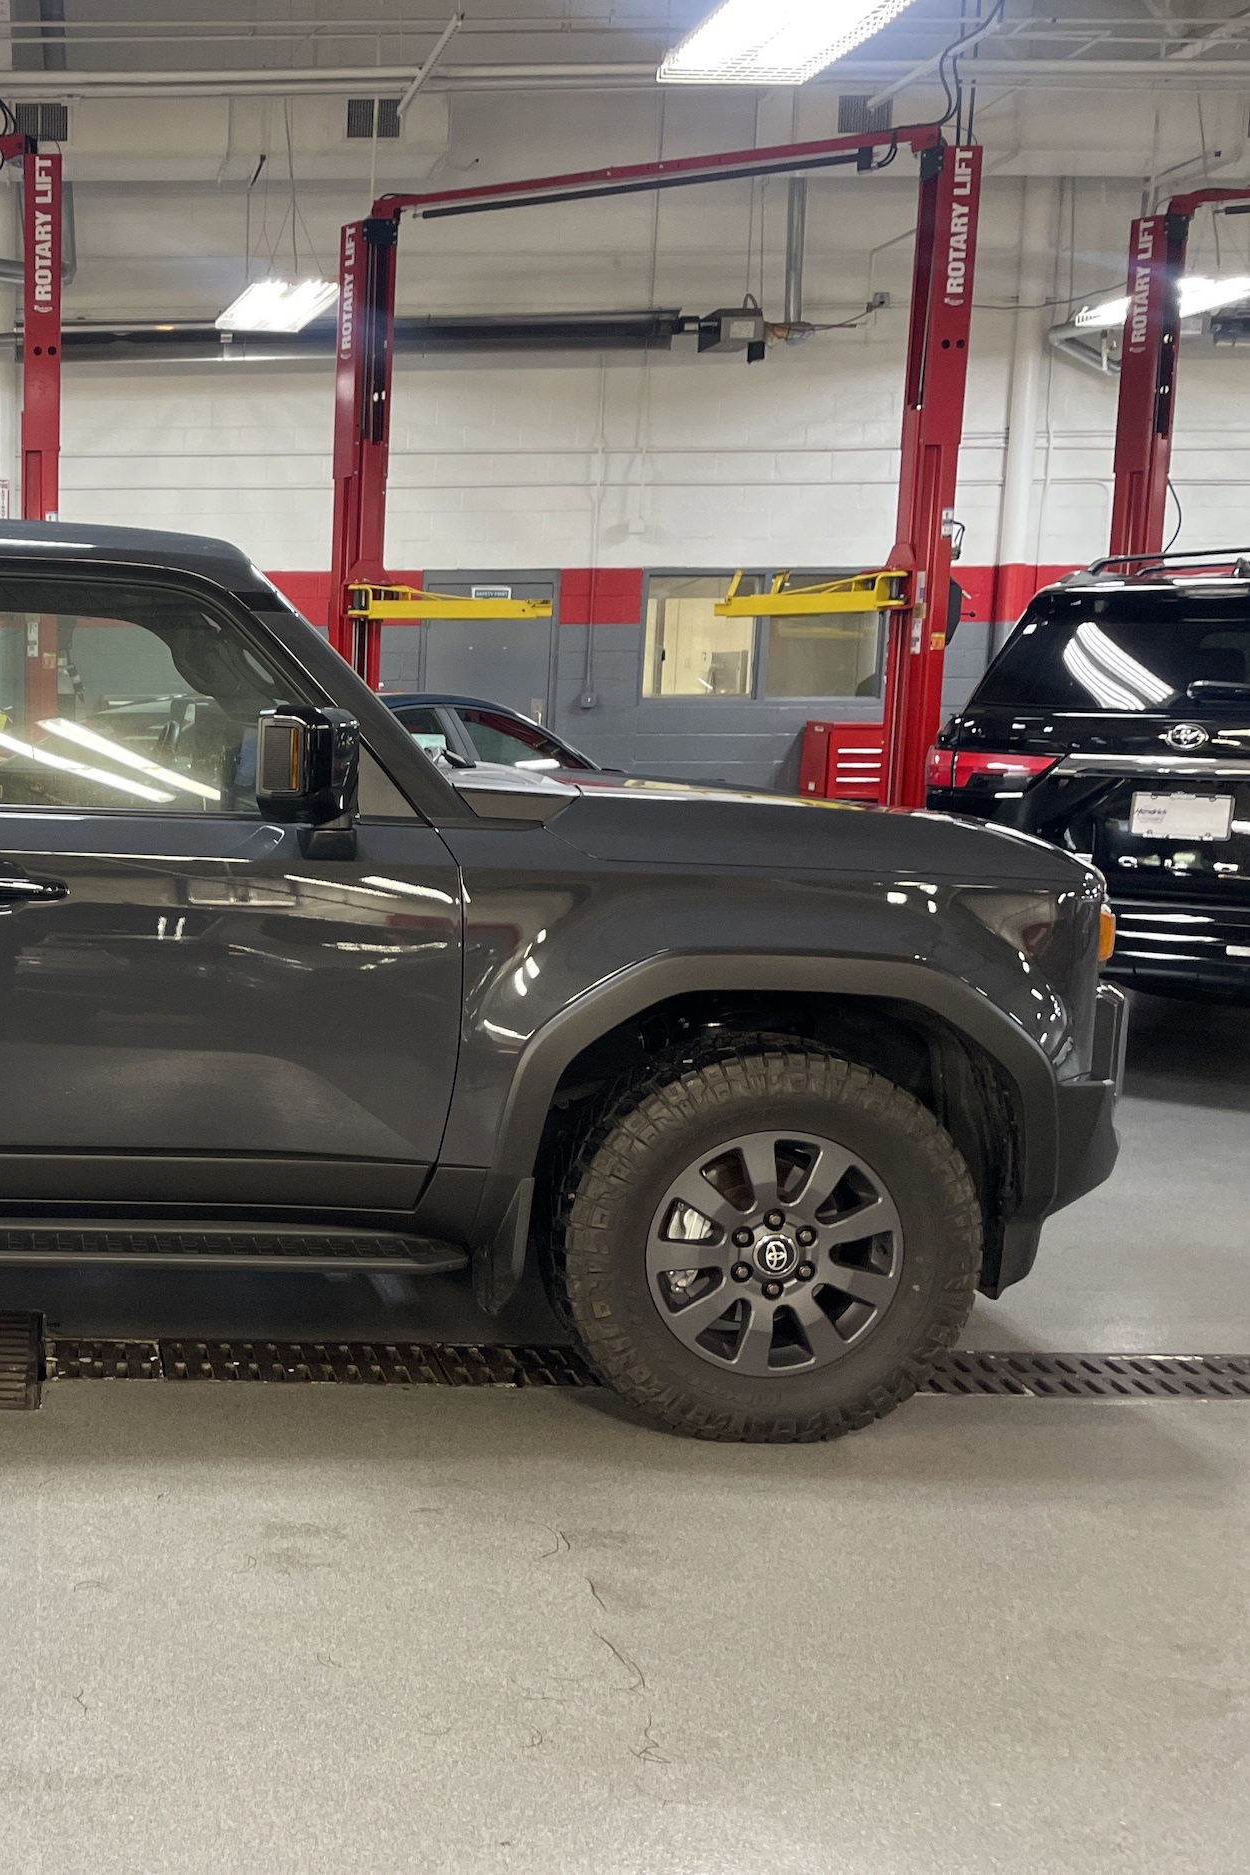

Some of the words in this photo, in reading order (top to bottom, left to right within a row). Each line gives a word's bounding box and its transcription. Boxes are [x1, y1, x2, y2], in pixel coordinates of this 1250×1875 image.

[35, 156, 52, 204] LIFT
[953, 147, 973, 196] LIFT
[34, 210, 52, 301] ROTARY
[344, 226, 356, 268] LIFT
[946, 202, 970, 294] ROTARY
[1137, 219, 1154, 261] LIFT
[341, 273, 354, 351] ROTARY
[1131, 266, 1151, 344] ROTARY
[1135, 807, 1168, 816] Hendrick
